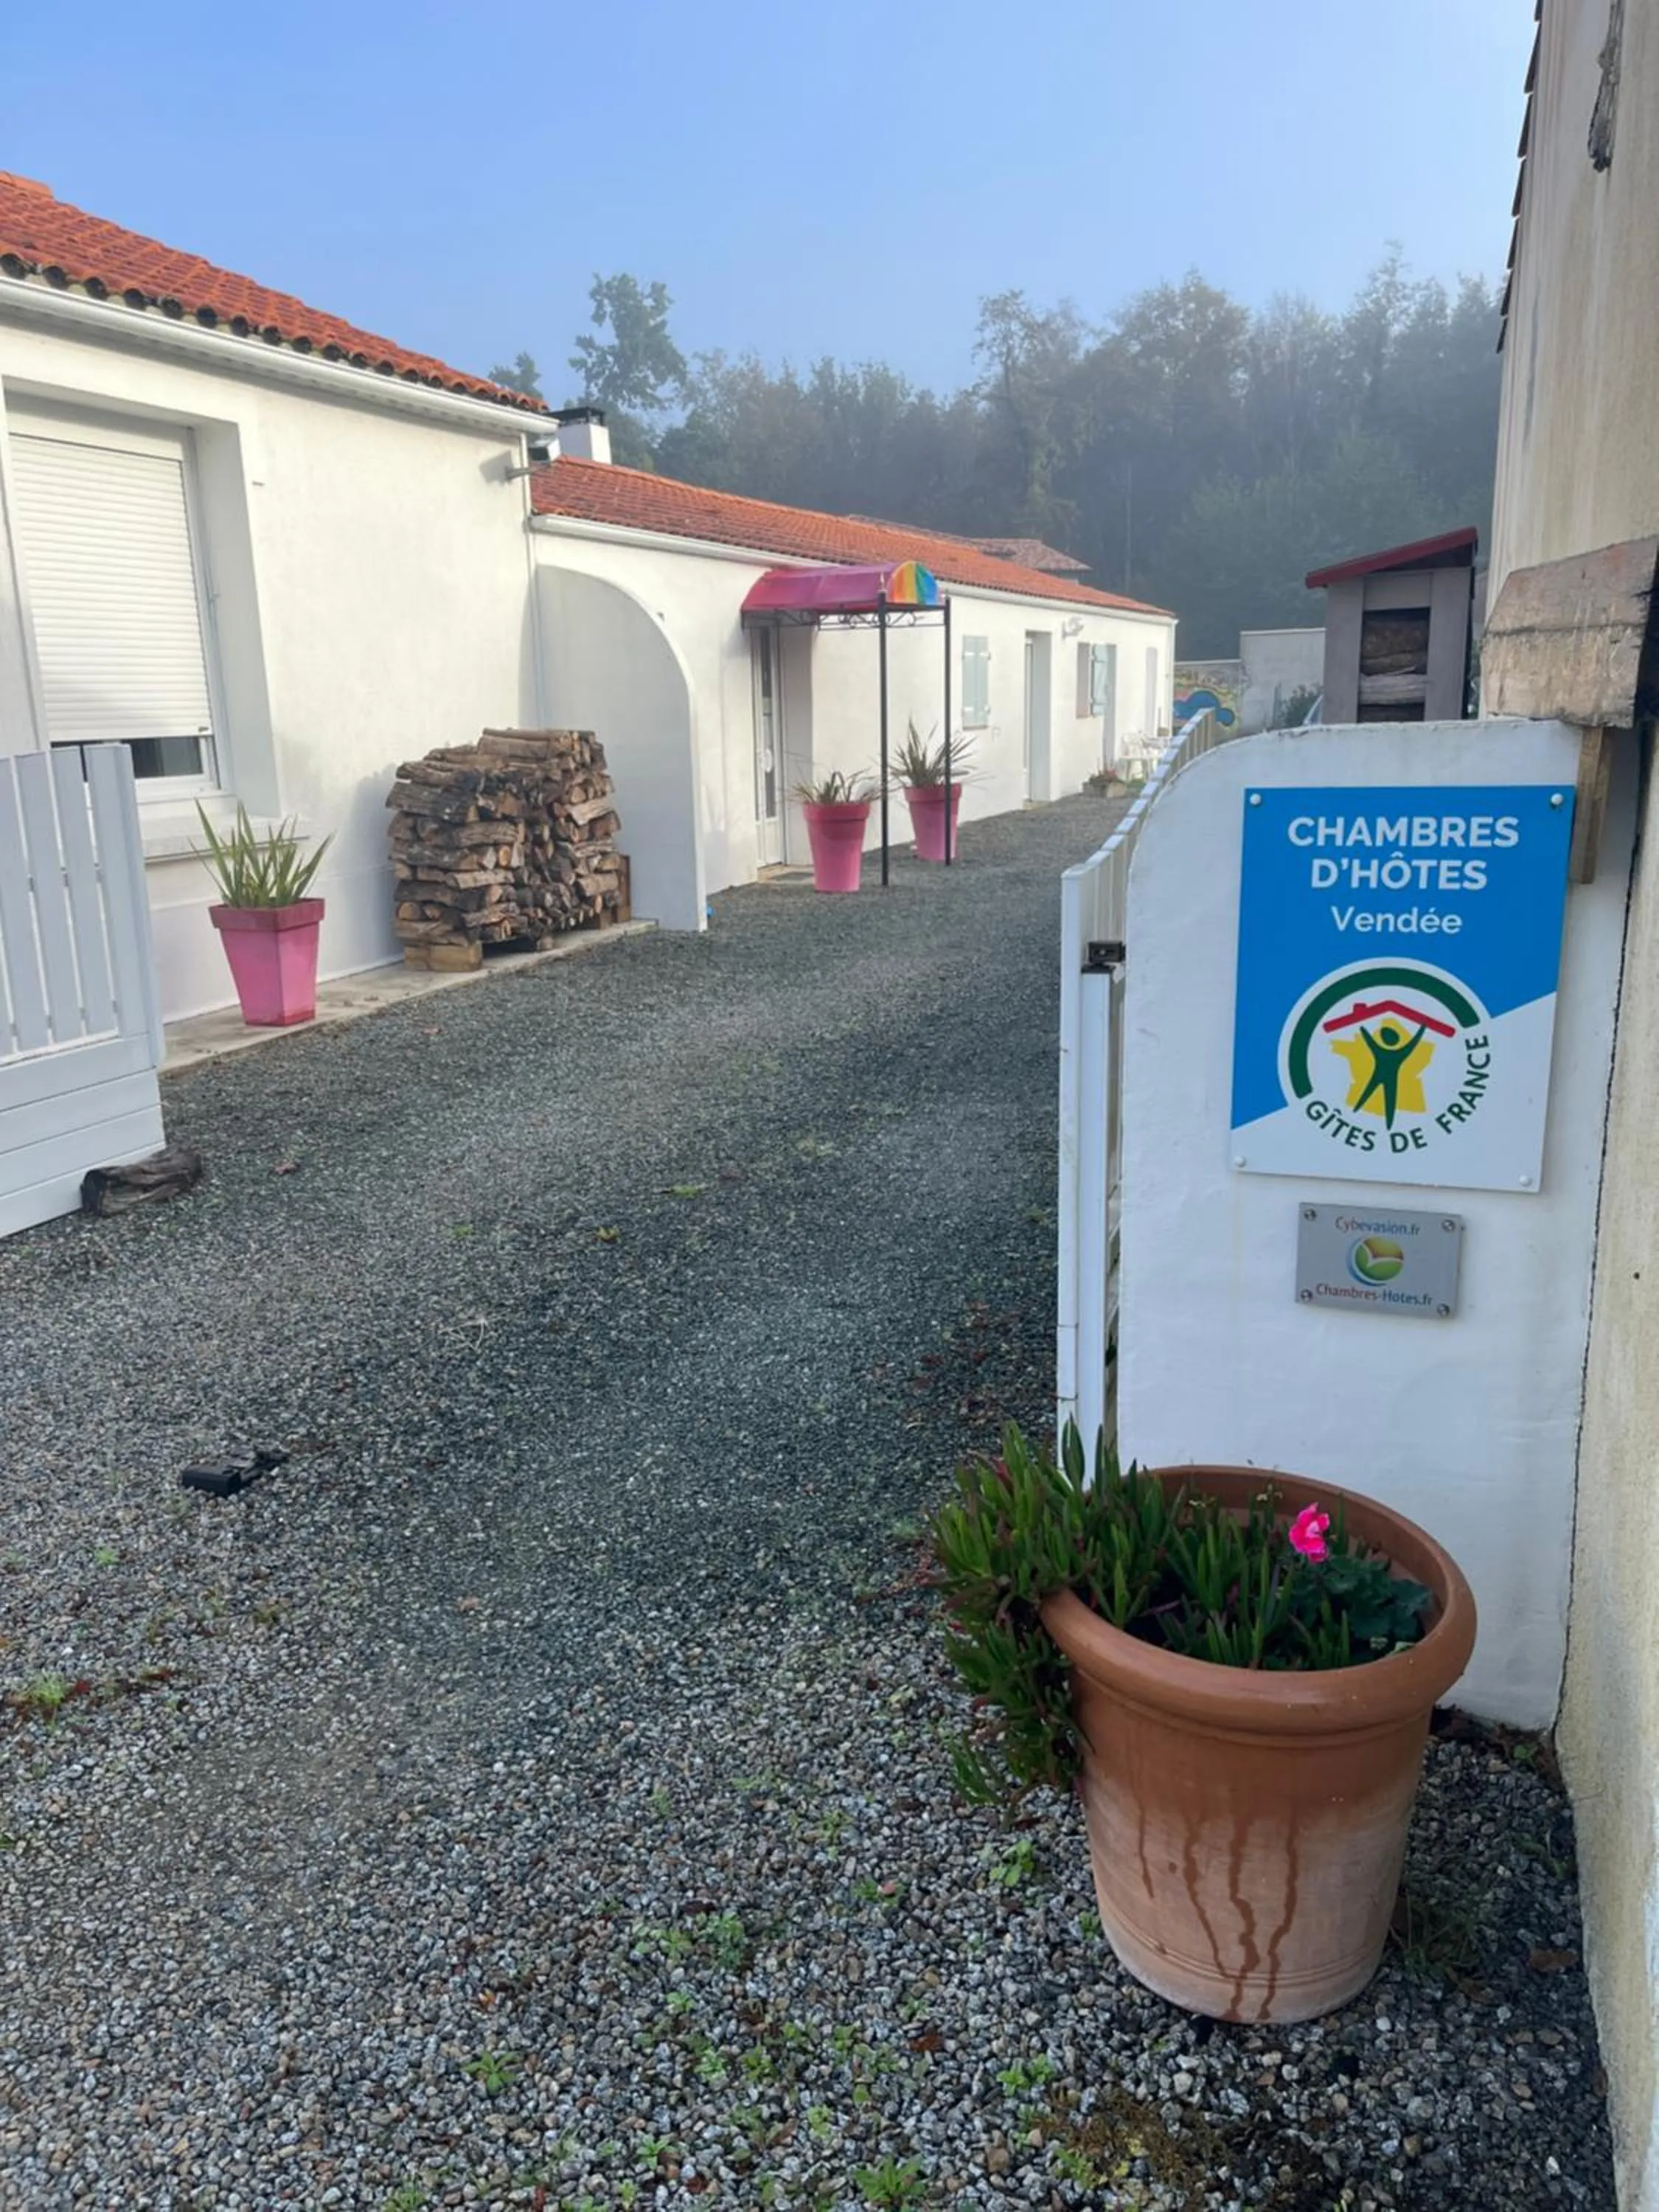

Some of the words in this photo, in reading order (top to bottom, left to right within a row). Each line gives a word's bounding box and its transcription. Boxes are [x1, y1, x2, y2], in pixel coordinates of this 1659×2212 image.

[1287, 816, 1520, 848] CHAMBRES
[1311, 851, 1487, 891] D'HÔTES
[1330, 905, 1463, 934] Vendée
[1305, 1100, 1376, 1152] GÎTES
[1390, 1127, 1428, 1153] DE
[1434, 1034, 1491, 1135] FRANCE
[1335, 1216, 1421, 1237] Cybevasion.fr
